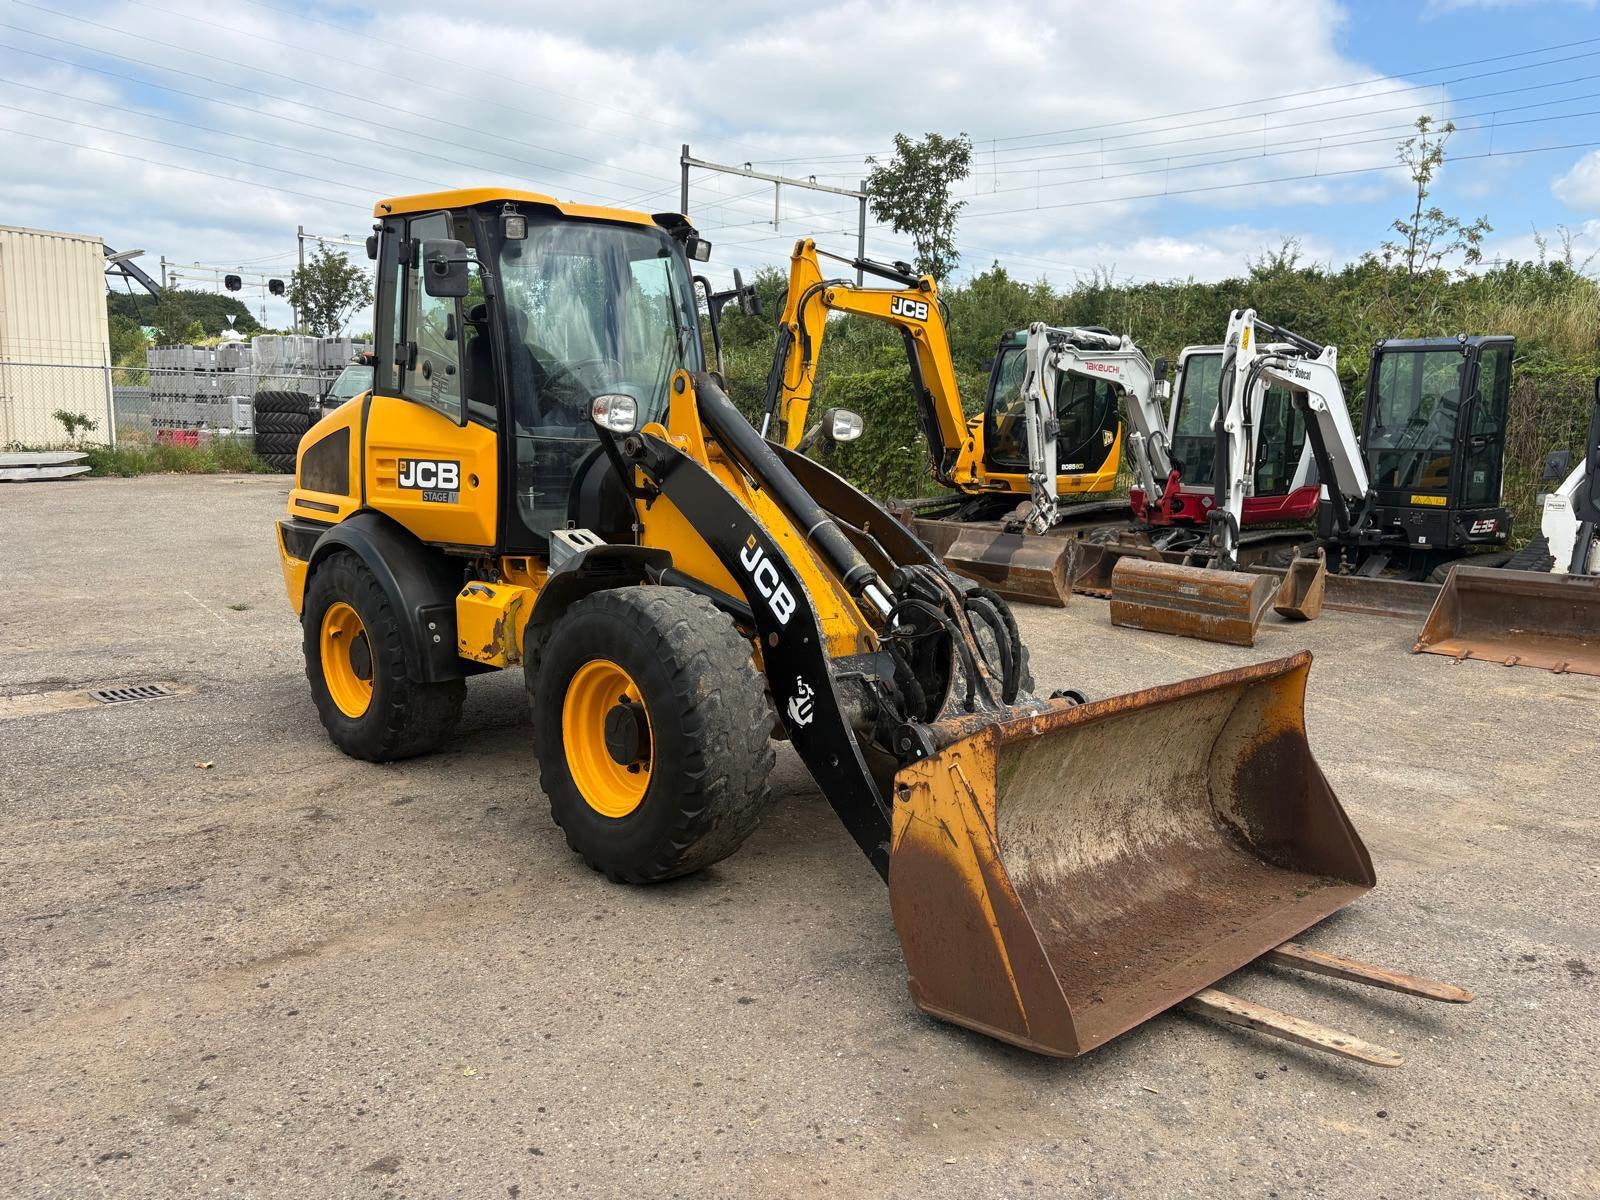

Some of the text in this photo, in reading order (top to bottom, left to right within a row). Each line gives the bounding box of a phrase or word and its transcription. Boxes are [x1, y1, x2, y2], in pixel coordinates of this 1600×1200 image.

[892, 298, 928, 320] JCB
[1295, 367, 1312, 381] Bobcat
[399, 461, 459, 489] JCB
[423, 491, 448, 502] STAGE
[740, 546, 796, 625] JCB
